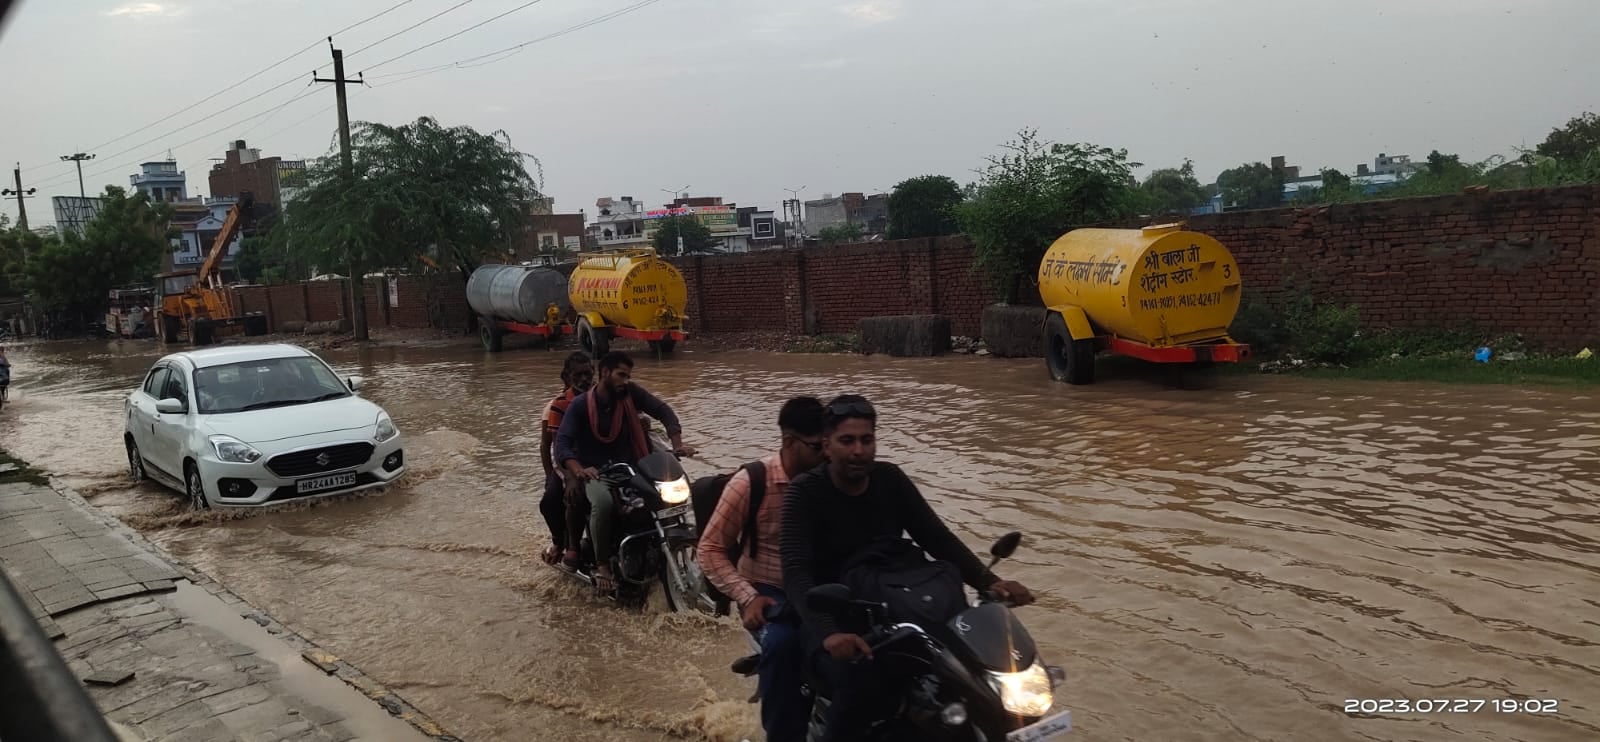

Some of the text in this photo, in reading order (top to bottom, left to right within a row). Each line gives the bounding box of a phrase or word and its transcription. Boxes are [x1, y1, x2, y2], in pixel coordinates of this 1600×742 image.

[1160, 249, 1186, 266] बाला
[1186, 244, 1201, 263] जी
[623, 299, 629, 309] 6
